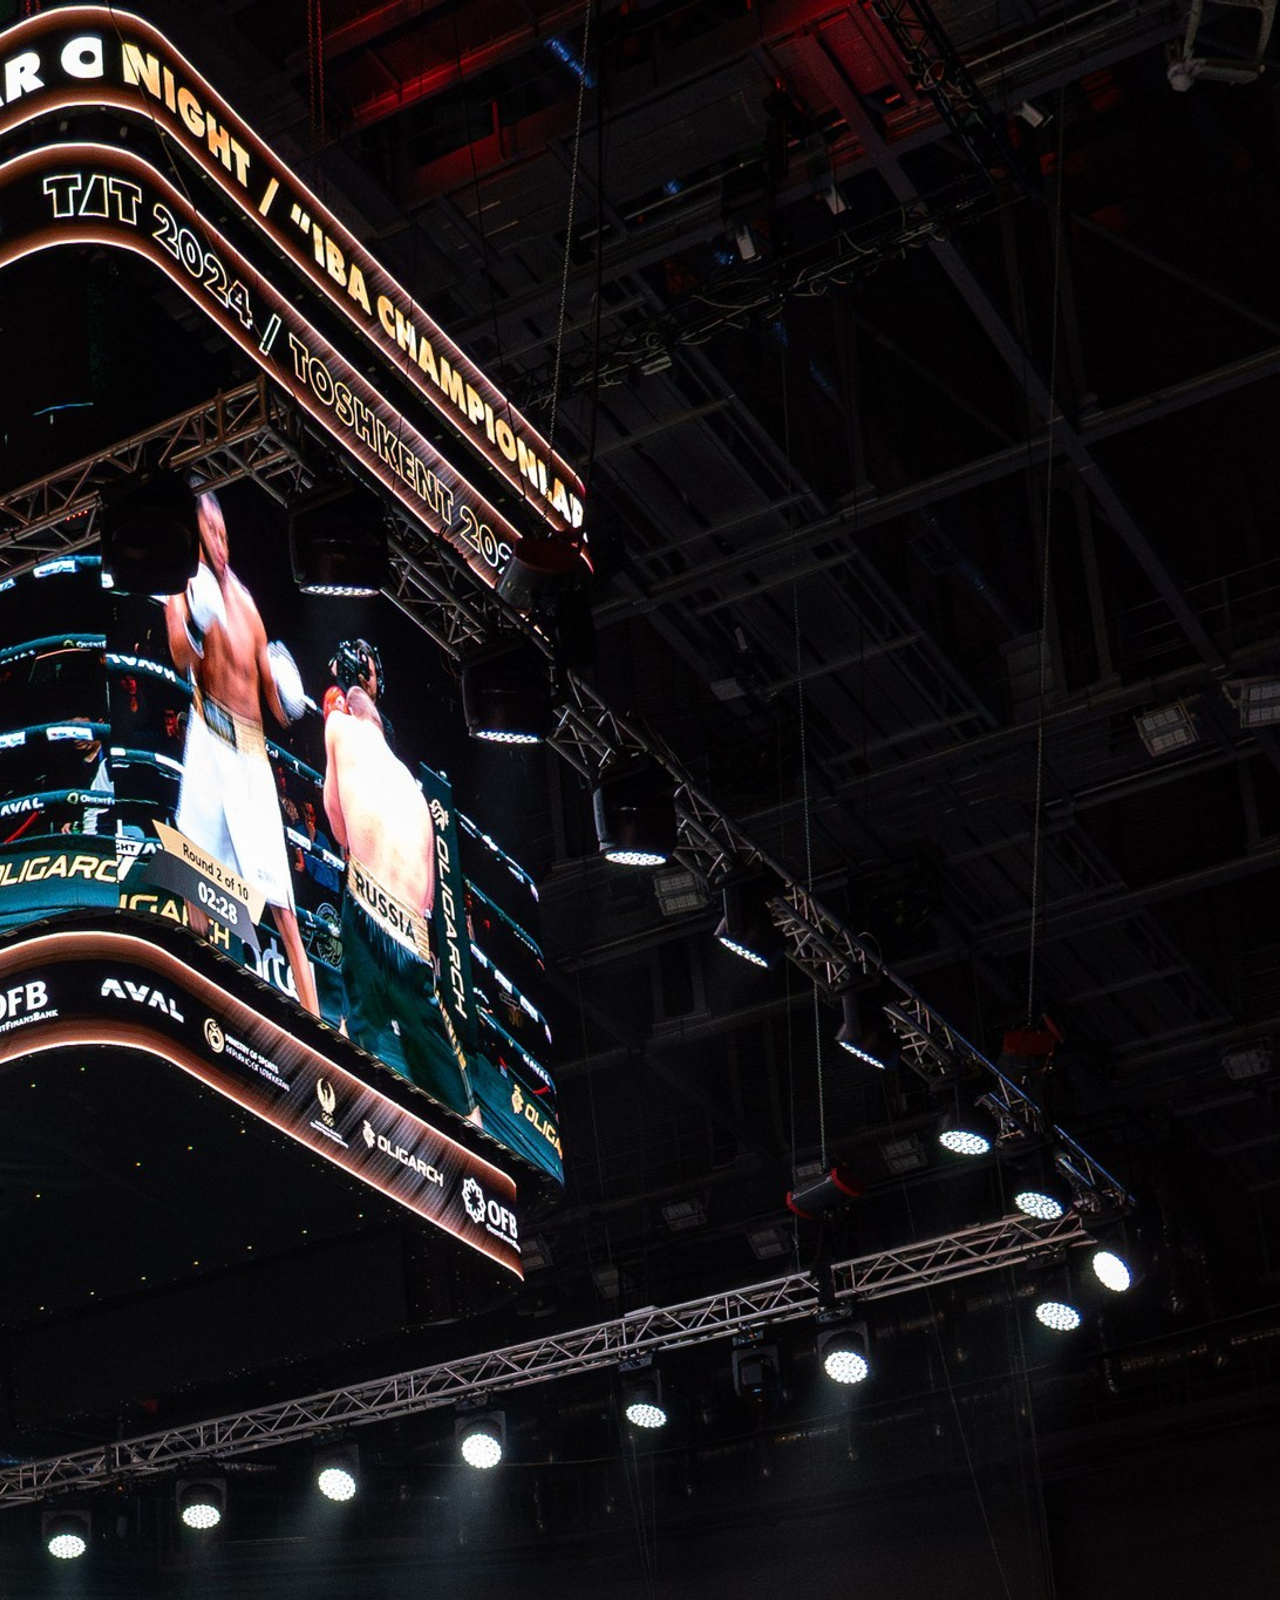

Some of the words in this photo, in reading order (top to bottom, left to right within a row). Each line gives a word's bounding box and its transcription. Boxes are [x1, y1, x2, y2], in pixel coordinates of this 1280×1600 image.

[122, 43, 251, 187] NIGHT
[151, 202, 254, 330] 2024
[289, 331, 455, 526] TOSHKENT
[181, 842, 215, 877] Round
[215, 867, 223, 884] 2
[224, 874, 236, 891] of
[237, 882, 250, 901] 10
[197, 881, 239, 926] 02:28
[354, 870, 417, 945] RUSSIA
[435, 833, 468, 1021] OLIGARCH
[522, 1052, 551, 1087] HAVAL
[377, 1133, 445, 1190] OLIGARCH
[487, 1200, 519, 1240] OFB
